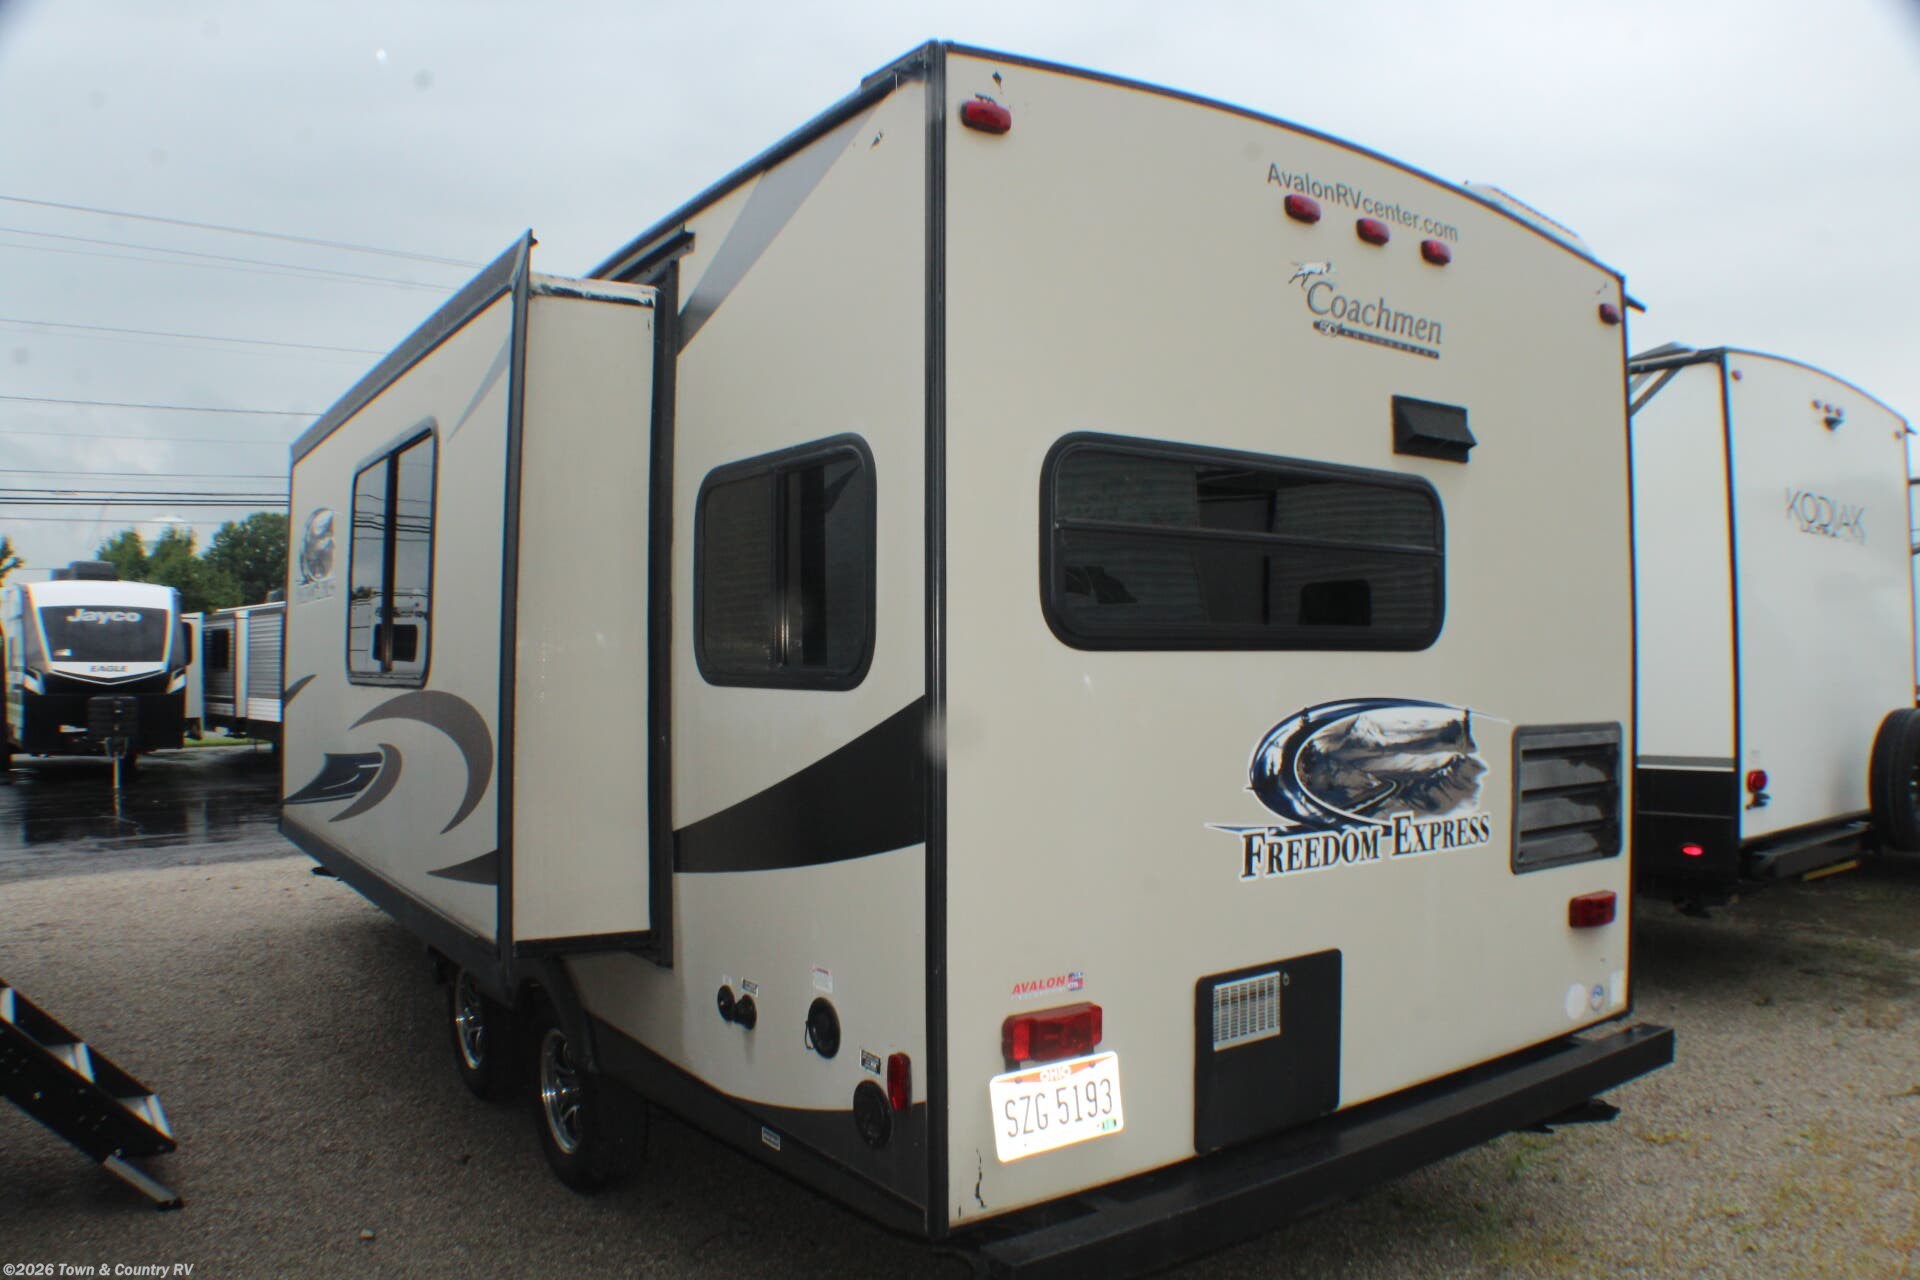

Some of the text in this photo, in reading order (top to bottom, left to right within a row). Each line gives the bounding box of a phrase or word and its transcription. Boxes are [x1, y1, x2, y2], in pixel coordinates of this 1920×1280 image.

[1267, 162, 1459, 241] AvalonRVcenter.com
[1306, 280, 1443, 345] Coachmen
[66, 608, 141, 624] Jayco
[1241, 814, 1491, 878] FREEDOM EXPRESS
[1011, 975, 1066, 995] AVALON
[1005, 1079, 1112, 1138] SZG 5193
